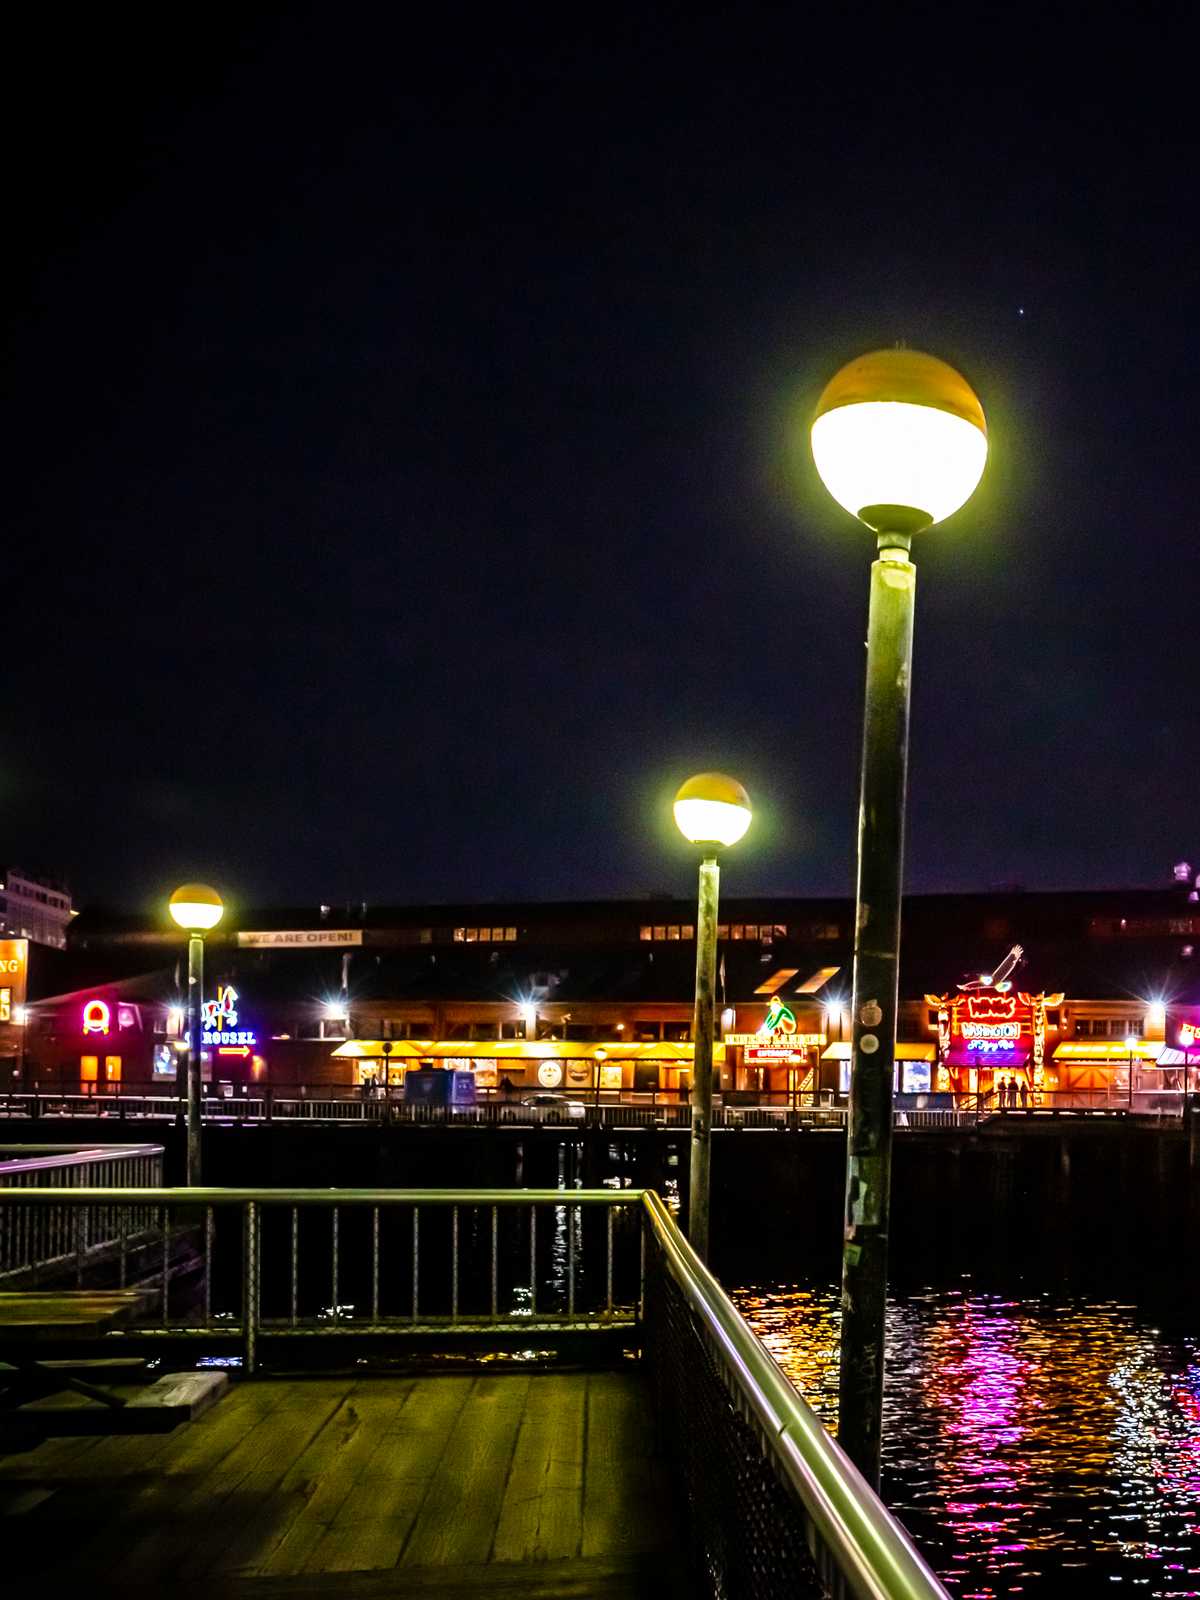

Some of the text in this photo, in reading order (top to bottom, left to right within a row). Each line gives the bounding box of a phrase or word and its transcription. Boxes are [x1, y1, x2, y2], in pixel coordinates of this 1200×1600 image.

[247, 932, 353, 944] WE ARE OPEN!
